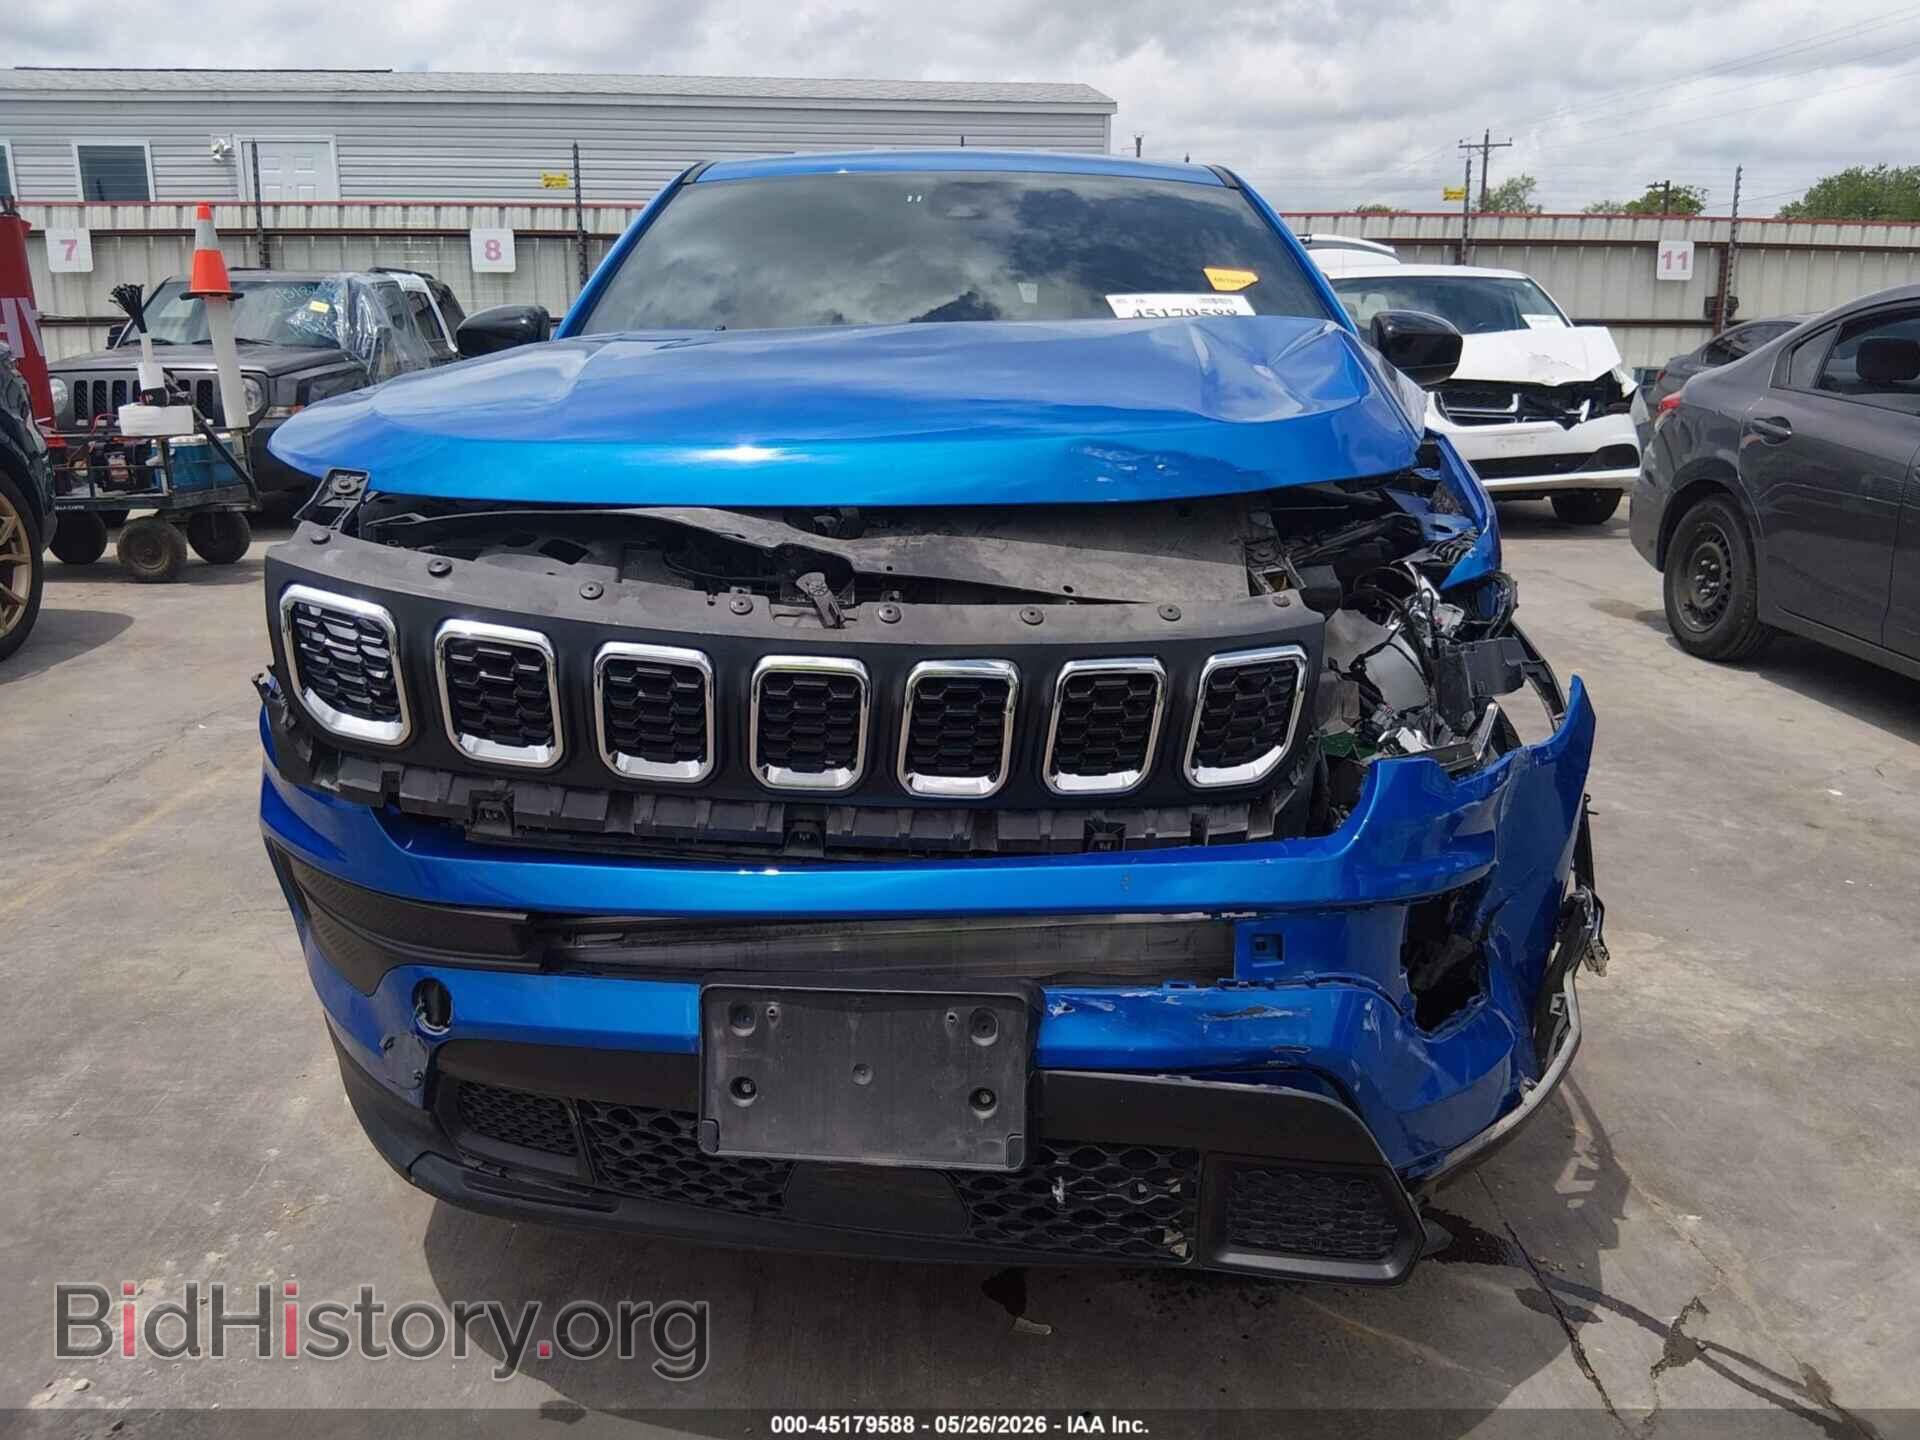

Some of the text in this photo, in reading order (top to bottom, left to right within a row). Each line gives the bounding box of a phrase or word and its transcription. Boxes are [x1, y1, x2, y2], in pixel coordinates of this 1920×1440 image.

[60, 239, 78, 261] 7
[485, 239, 502, 261] 8
[1661, 250, 1688, 270] 11
